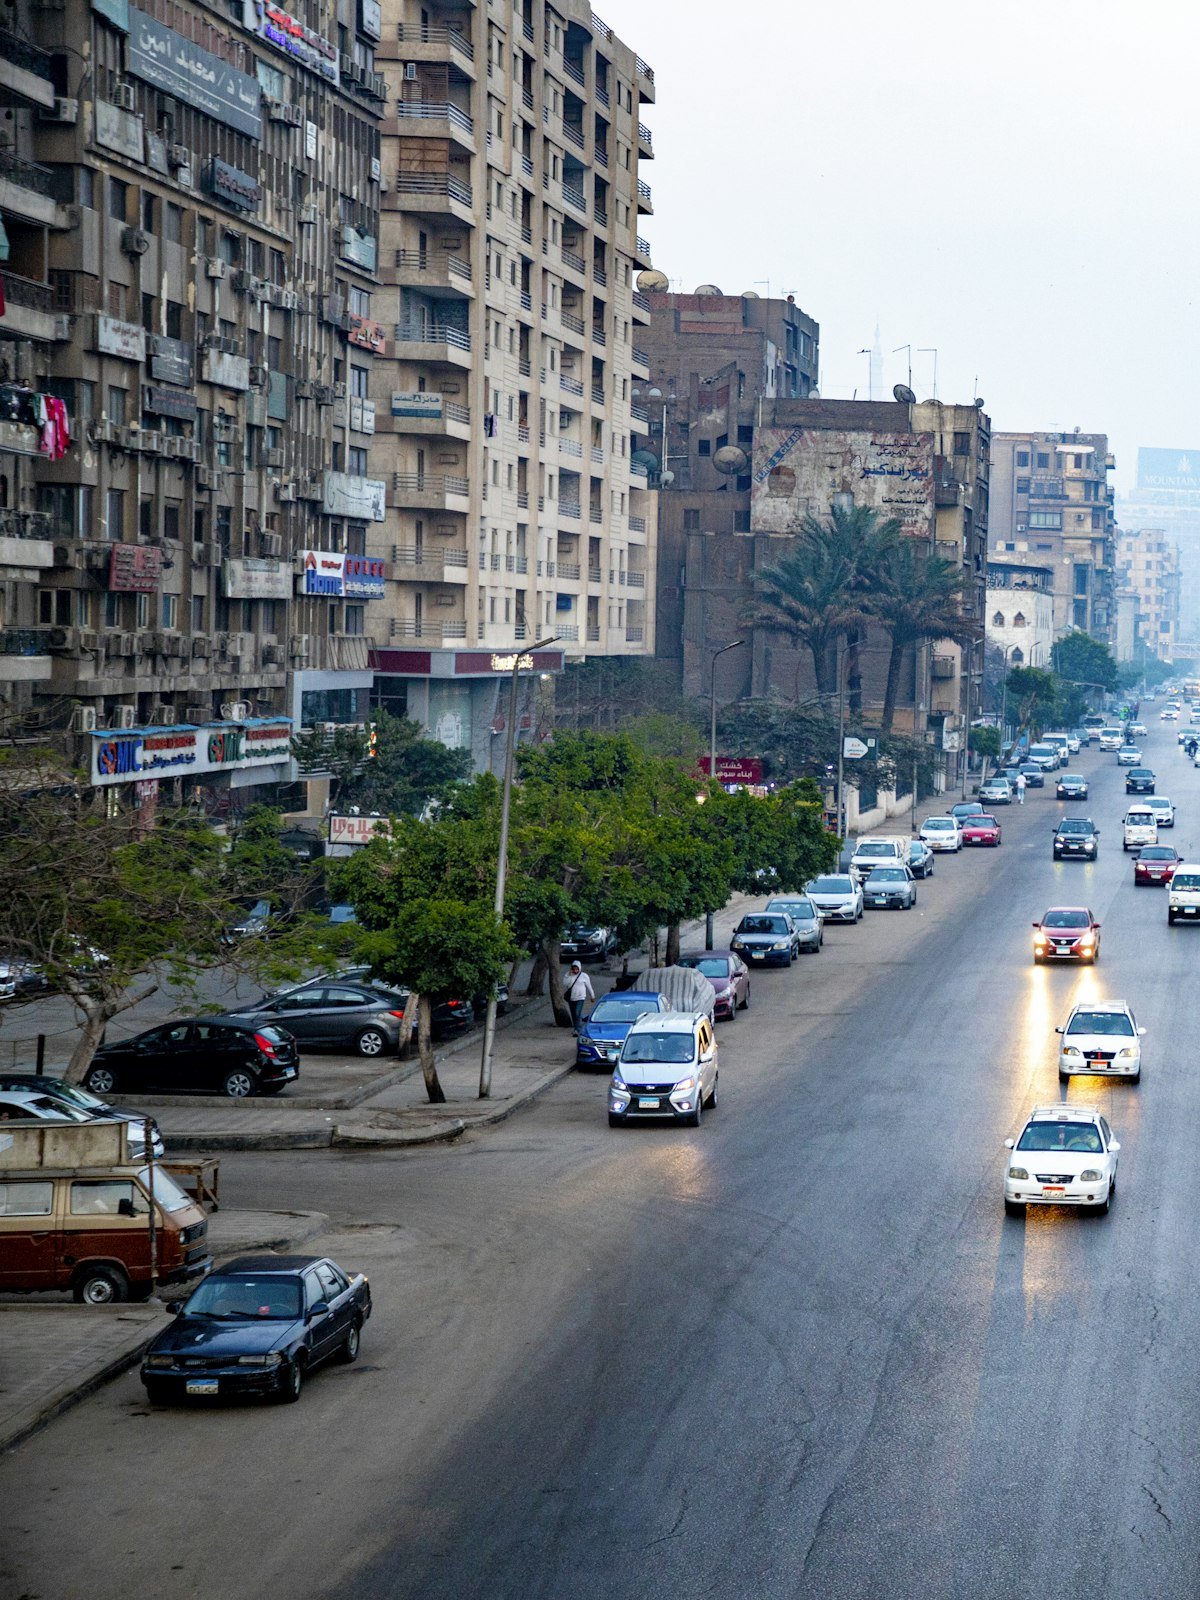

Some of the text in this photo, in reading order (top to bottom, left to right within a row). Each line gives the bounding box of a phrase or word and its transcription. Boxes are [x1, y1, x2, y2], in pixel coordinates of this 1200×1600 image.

[175, 49, 215, 83] محمد
[1145, 474, 1197, 487] MOUNTAIN
[737, 771, 753, 779] ابناء
